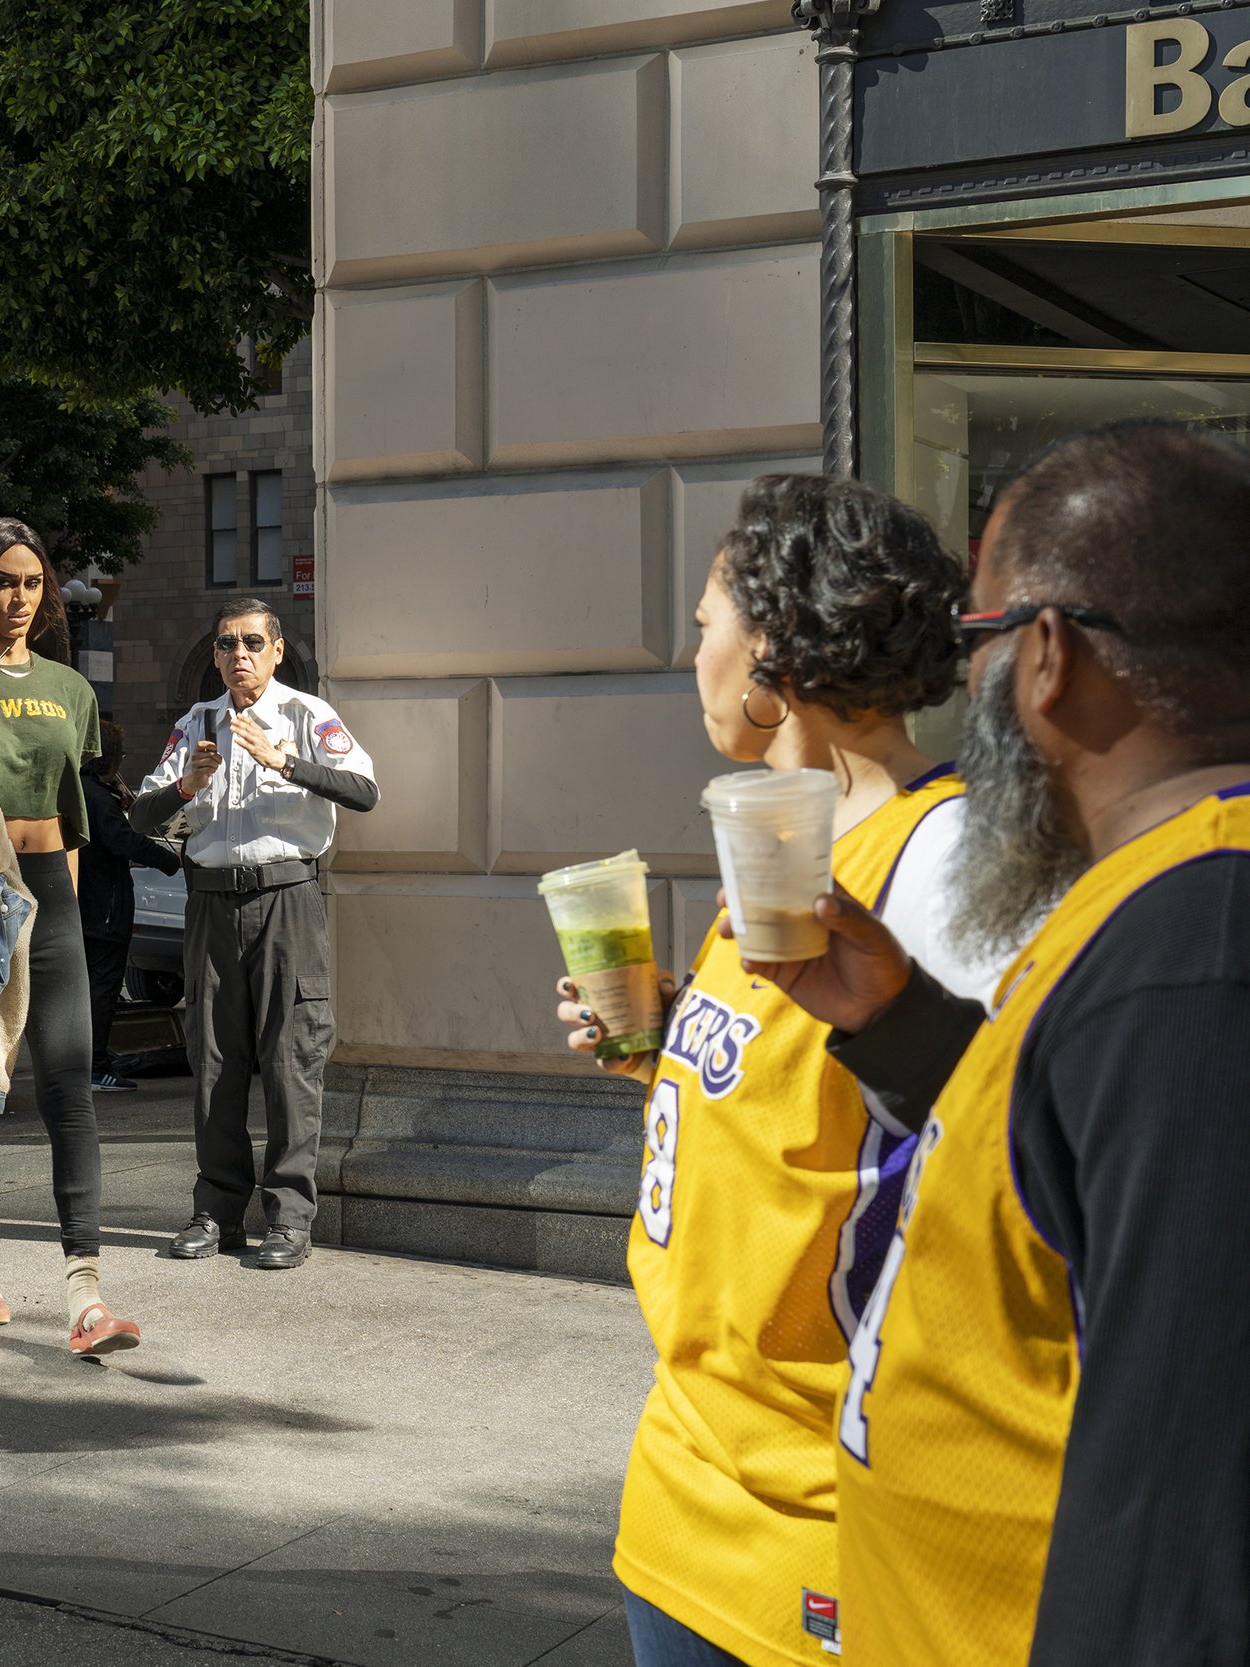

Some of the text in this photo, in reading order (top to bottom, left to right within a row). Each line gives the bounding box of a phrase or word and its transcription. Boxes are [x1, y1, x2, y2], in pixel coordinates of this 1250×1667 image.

[296, 571, 311, 580] For
[0, 698, 67, 719] WOOD
[661, 988, 762, 1101] KERS
[639, 1078, 680, 1249] 8
